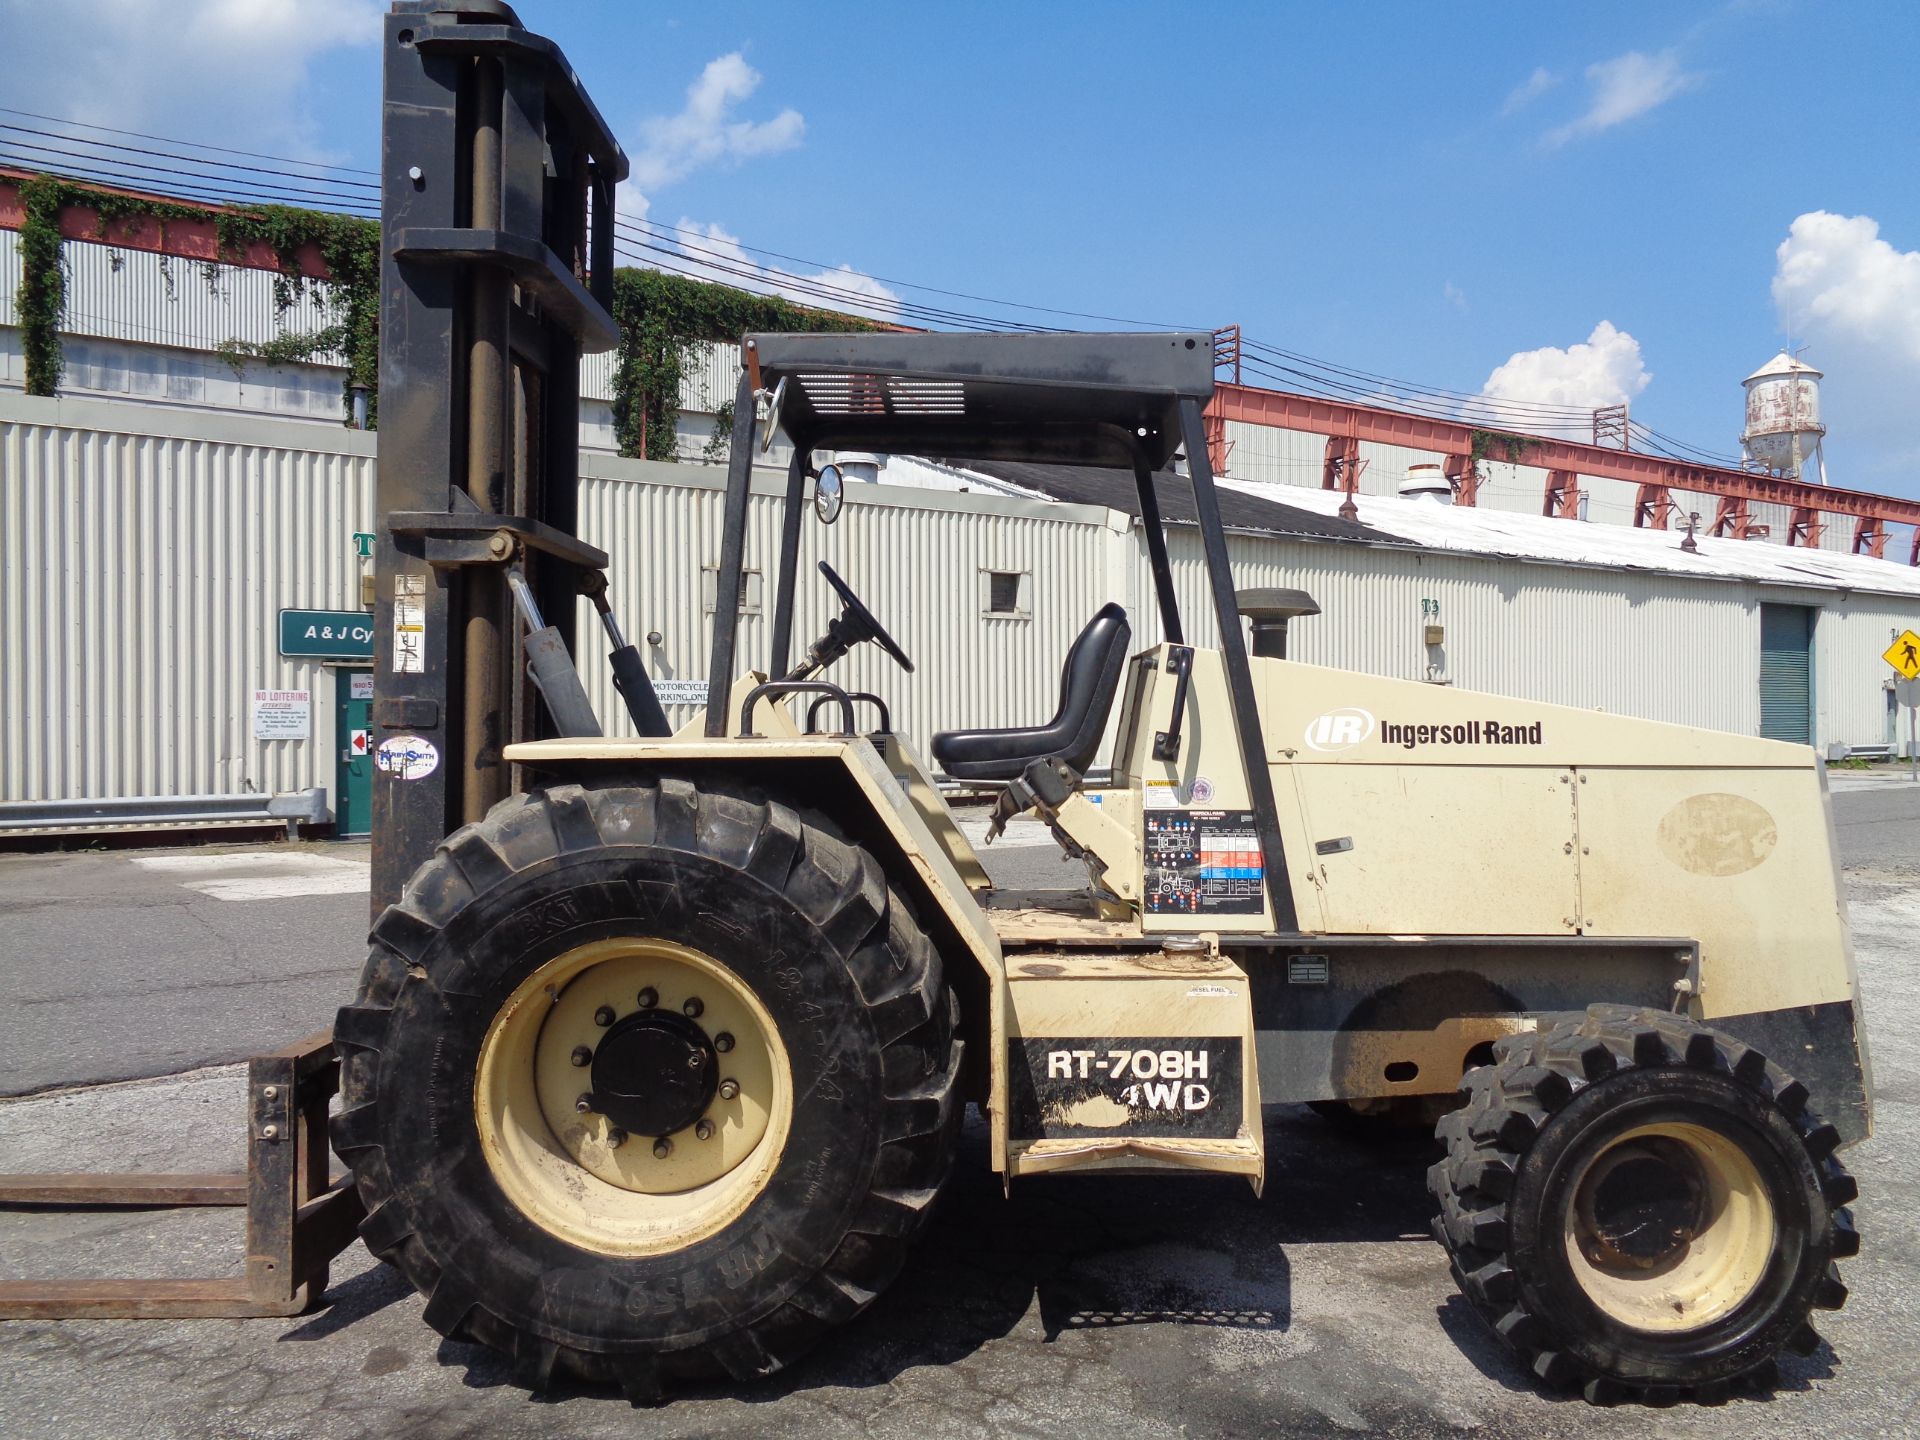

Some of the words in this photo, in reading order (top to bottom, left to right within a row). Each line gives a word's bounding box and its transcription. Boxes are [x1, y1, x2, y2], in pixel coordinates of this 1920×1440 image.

[1421, 599, 1439, 613] T3
[304, 625, 317, 639] A
[321, 626, 333, 639] &
[337, 626, 348, 640] J
[351, 627, 374, 643] Cy
[255, 692, 267, 701] NO
[269, 692, 308, 702] LOITERING
[1315, 715, 1363, 744] IR
[1047, 1050, 1208, 1079] RT-708H
